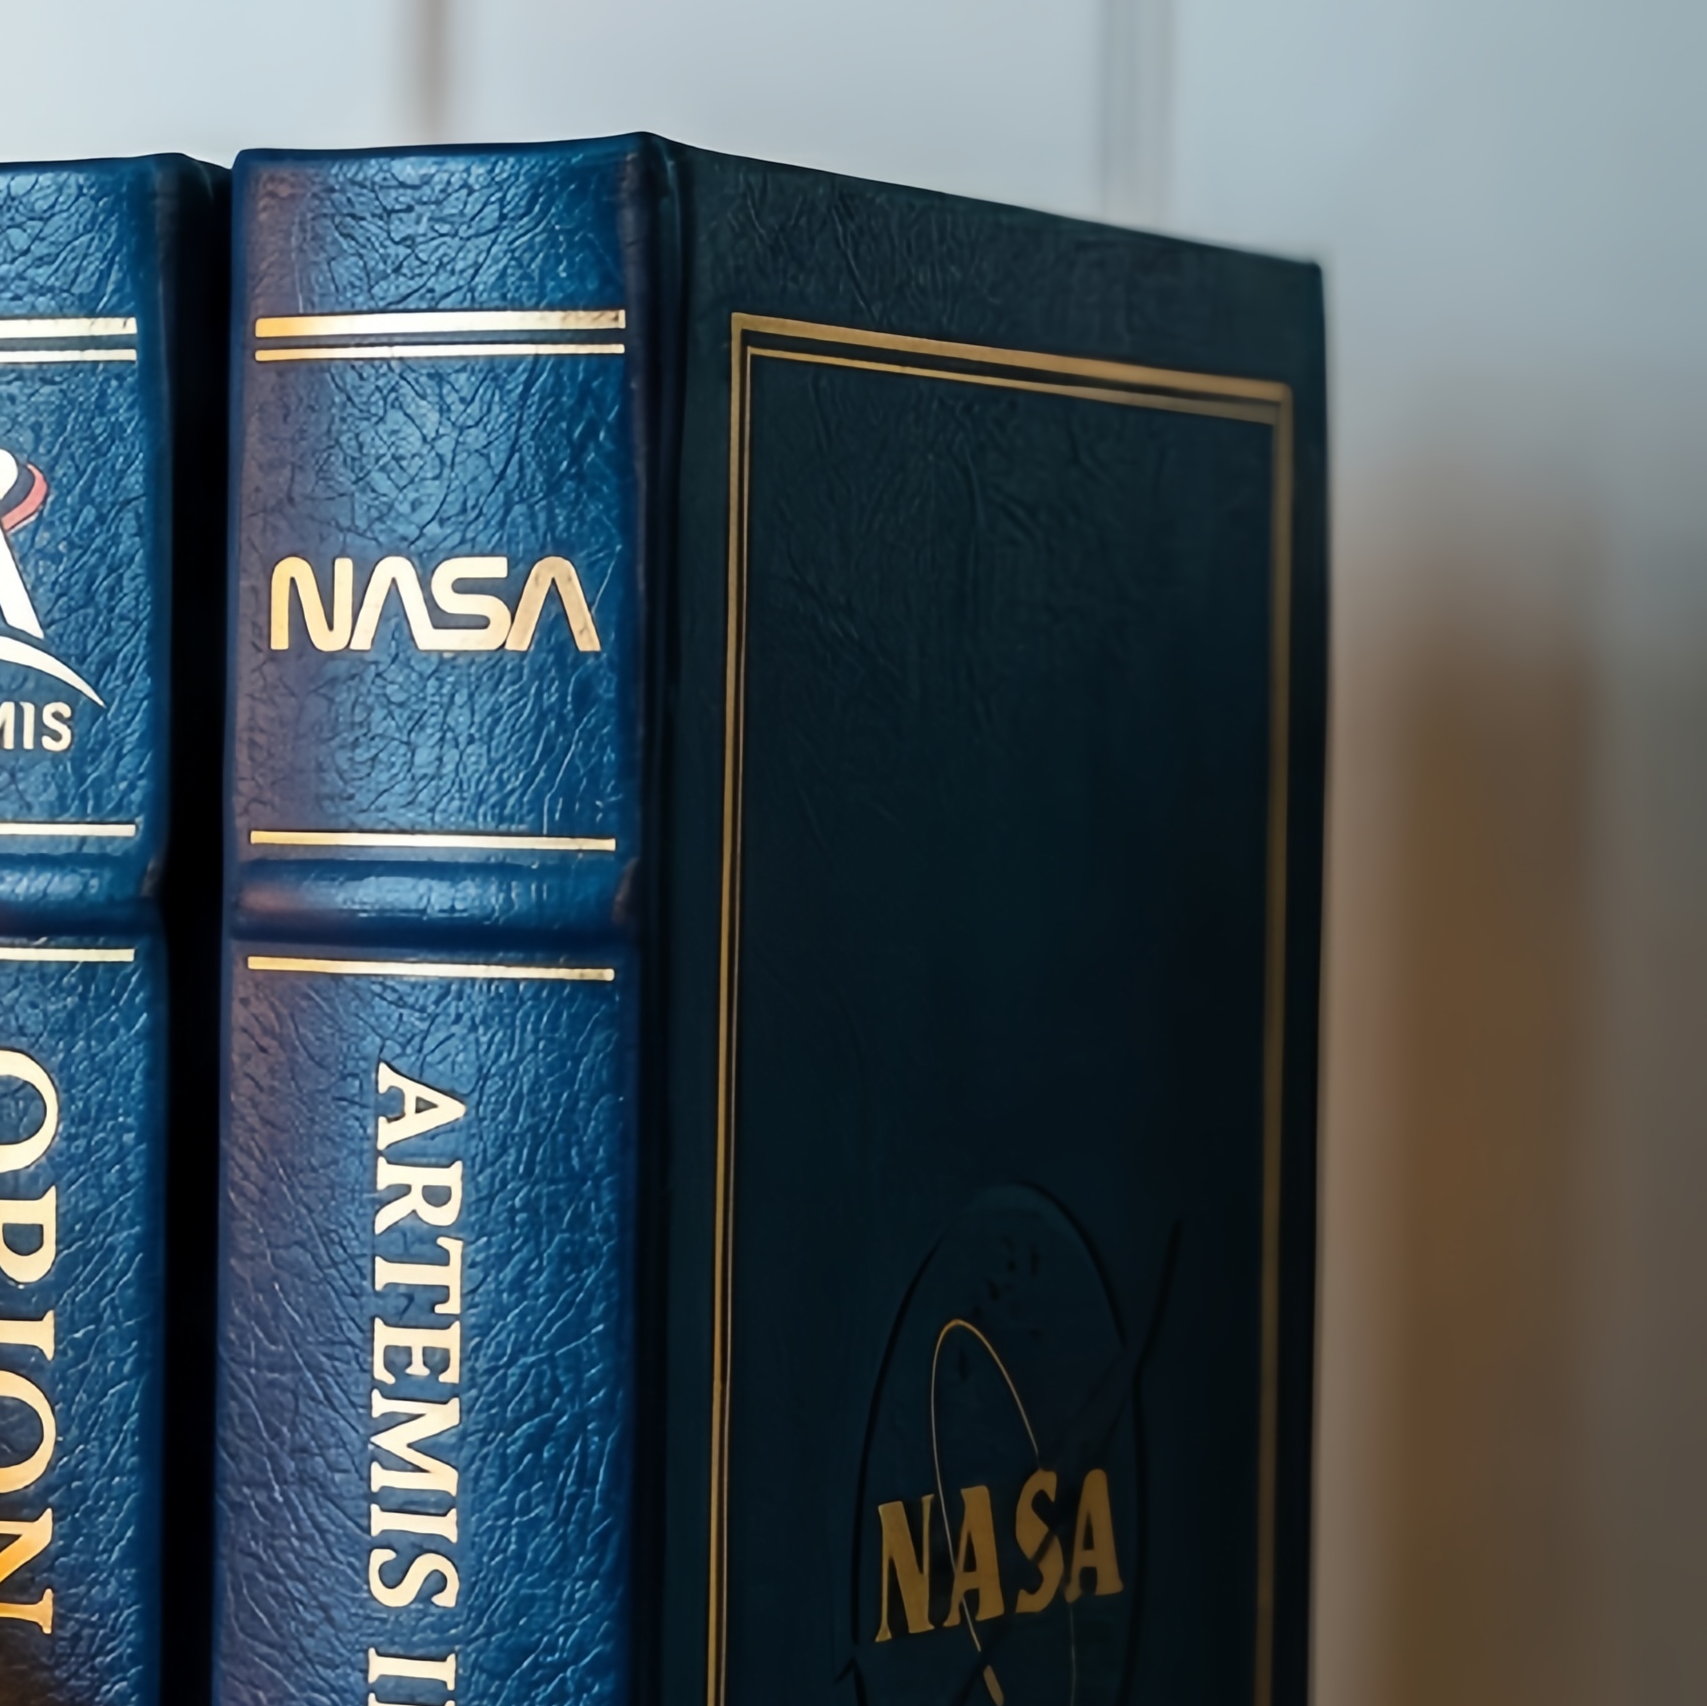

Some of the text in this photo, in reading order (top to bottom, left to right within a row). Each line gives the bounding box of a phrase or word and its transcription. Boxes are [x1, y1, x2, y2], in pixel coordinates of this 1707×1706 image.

[270, 556, 601, 652] NASA
[367, 1061, 467, 1609] ARTEMIS
[874, 1468, 1124, 1643] NASA
